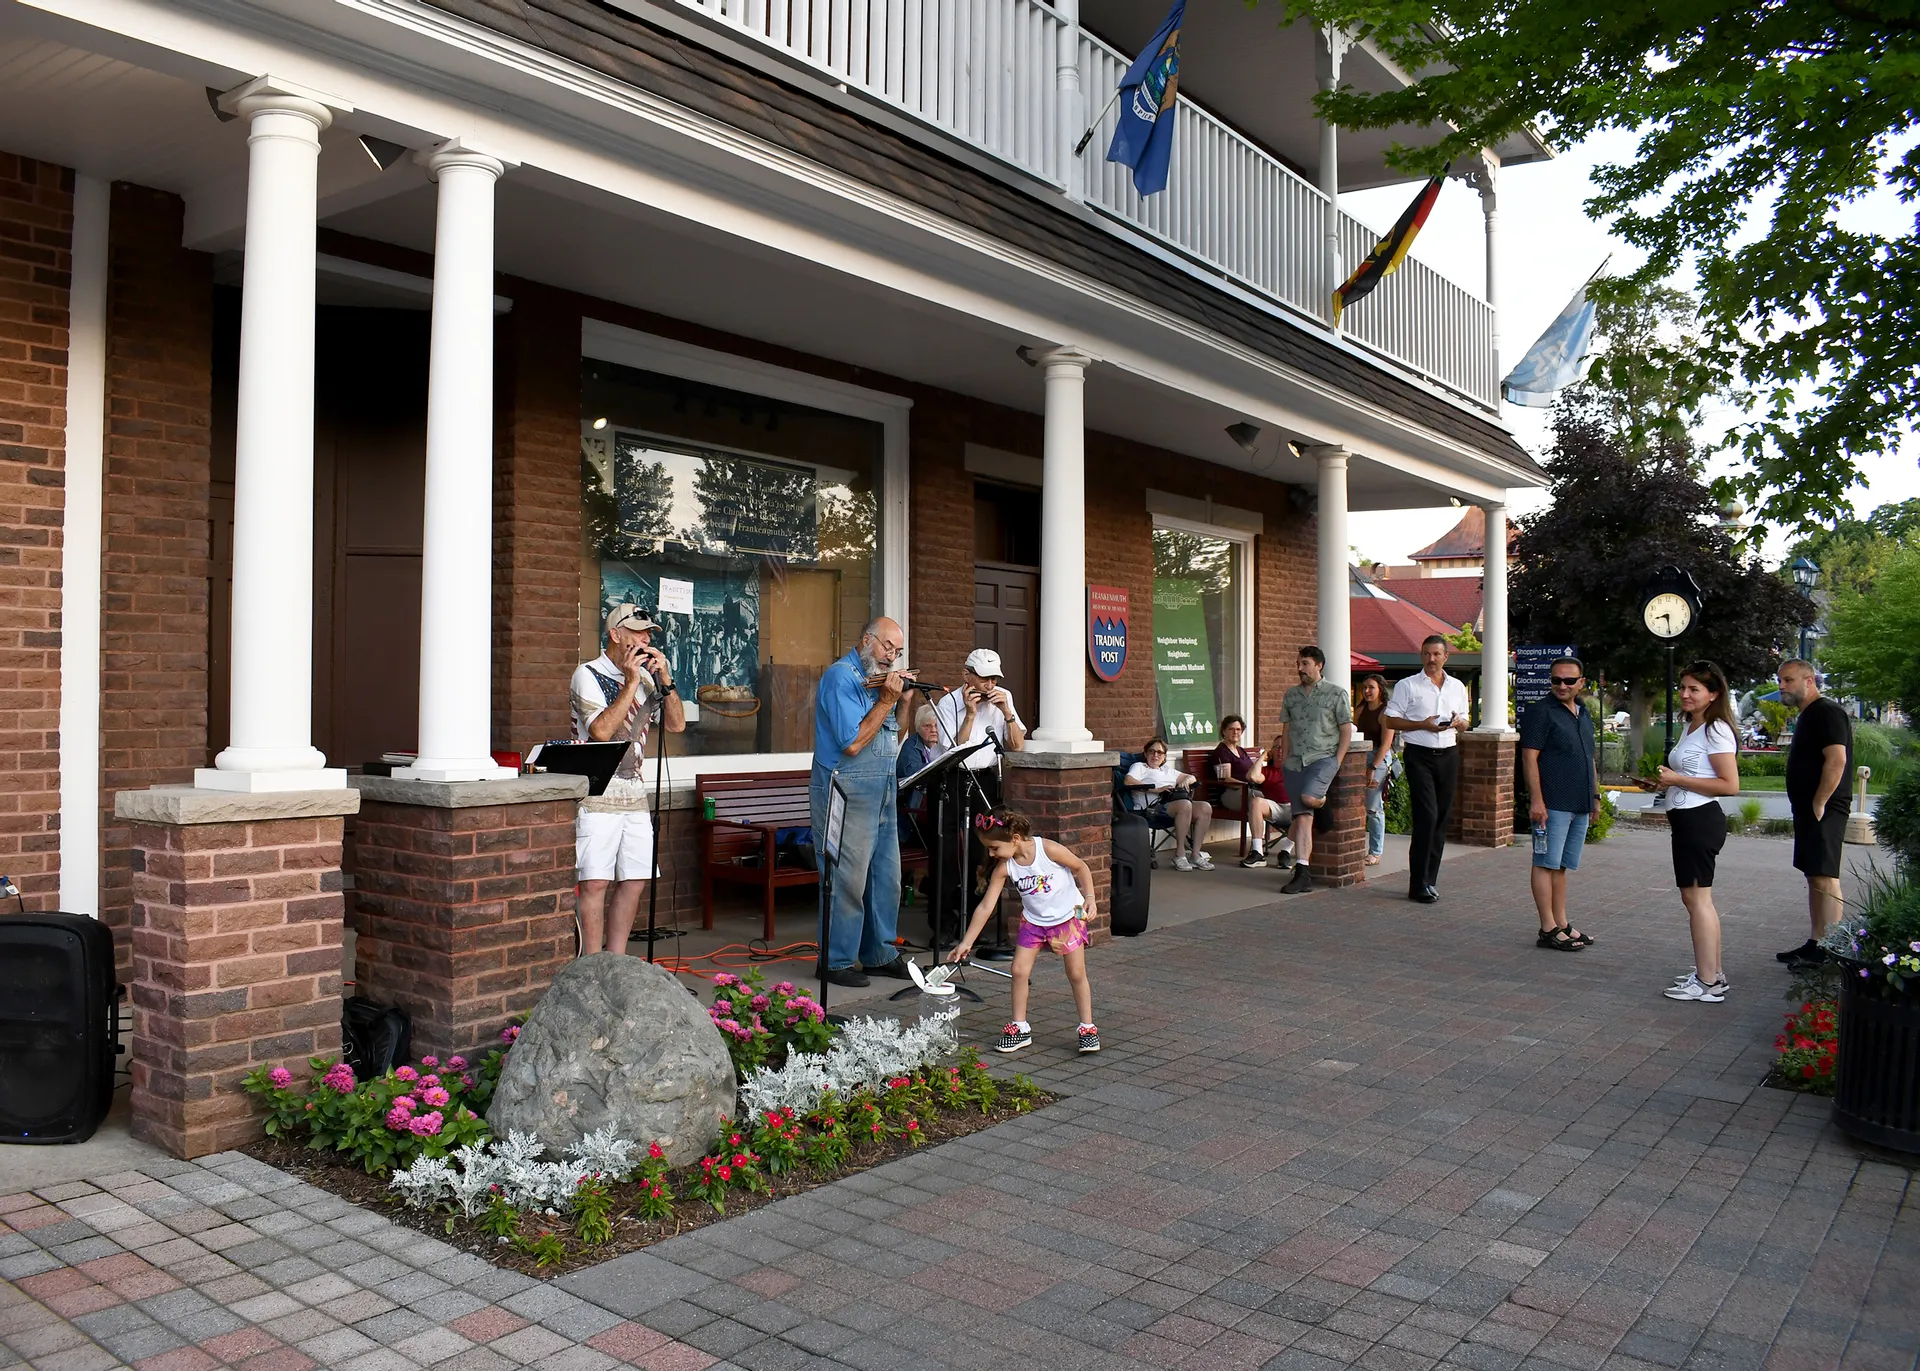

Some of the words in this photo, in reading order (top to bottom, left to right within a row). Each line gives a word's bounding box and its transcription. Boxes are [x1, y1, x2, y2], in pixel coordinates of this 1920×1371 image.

[1092, 592, 1127, 603] FRANKENMUTH
[1094, 634, 1125, 648] TRADING
[1157, 636, 1178, 645] Neighbor
[1101, 651, 1119, 663] POST
[1158, 663, 1187, 671] Frankenmuth
[1516, 677, 1551, 685] Glockenspi
